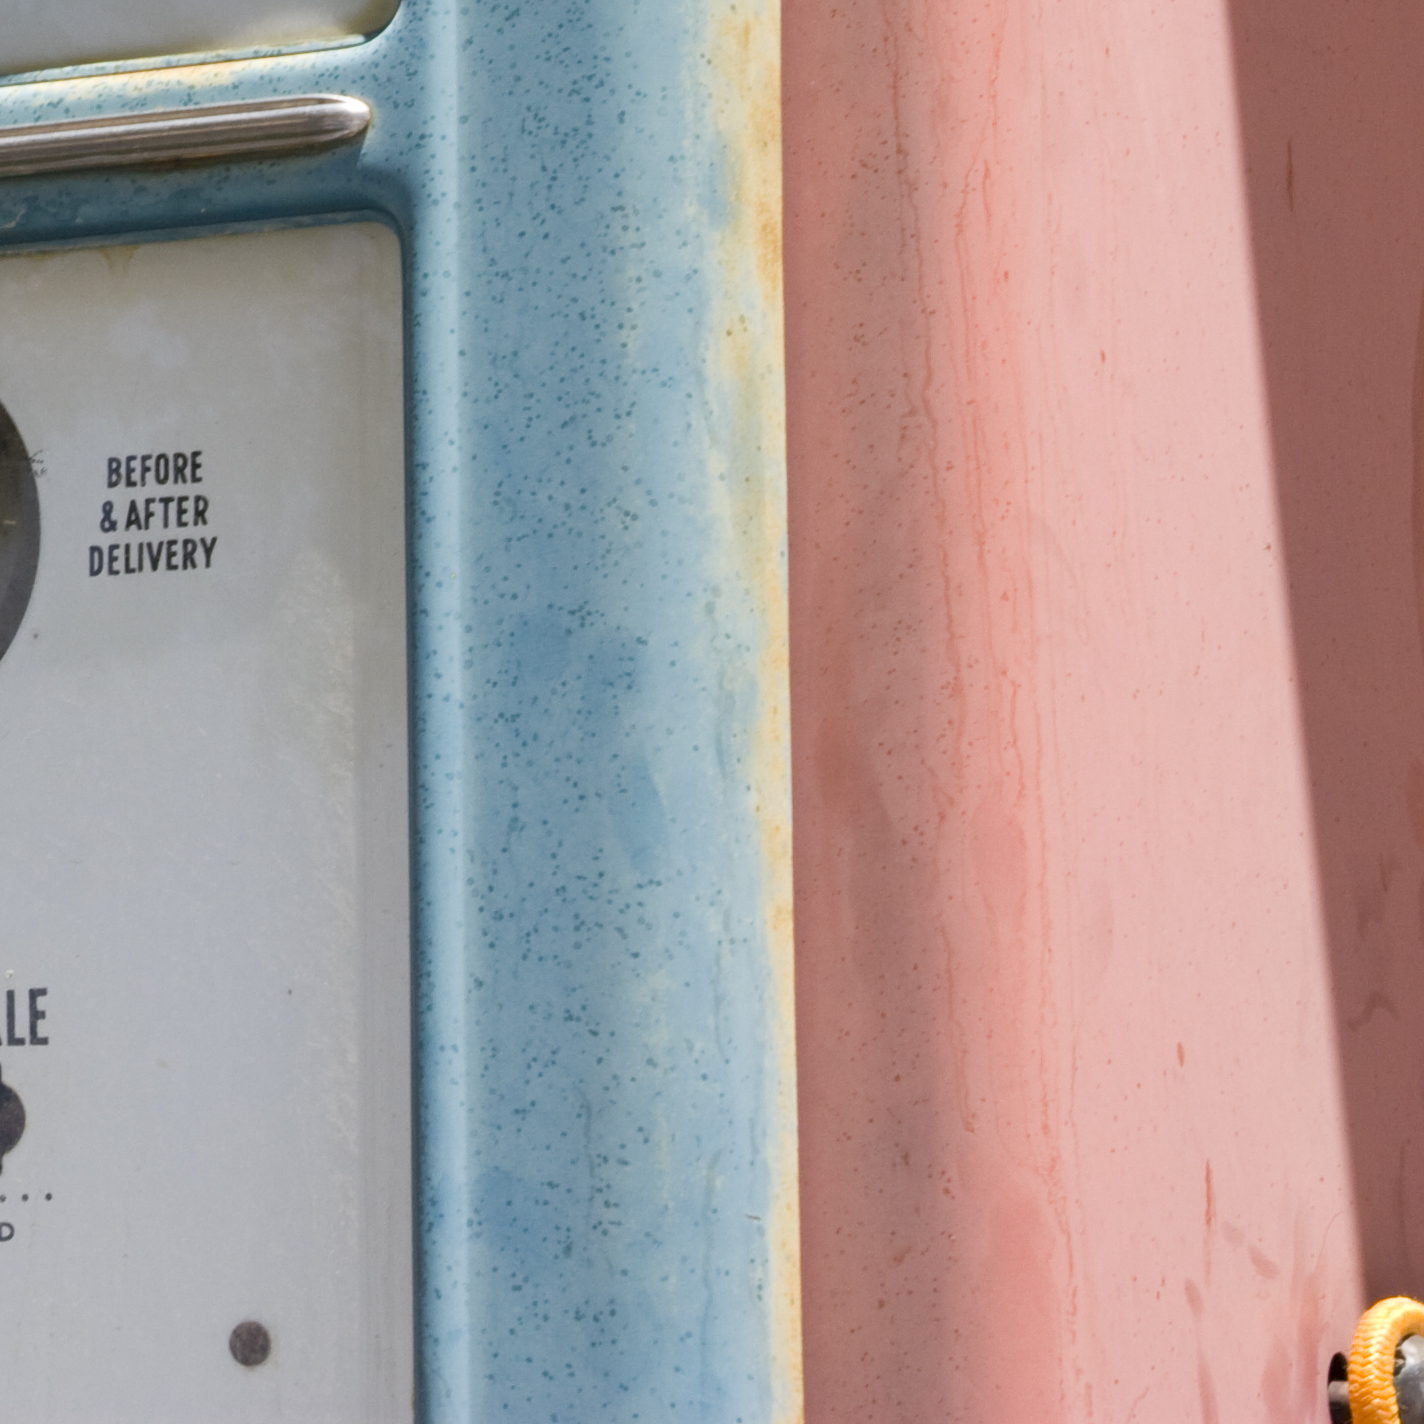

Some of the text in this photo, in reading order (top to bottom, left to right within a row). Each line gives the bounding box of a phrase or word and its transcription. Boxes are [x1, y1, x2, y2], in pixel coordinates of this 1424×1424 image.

[107, 451, 203, 488] BEFORE
[100, 495, 209, 533] & AFTER
[89, 536, 218, 577] DELIVERY
